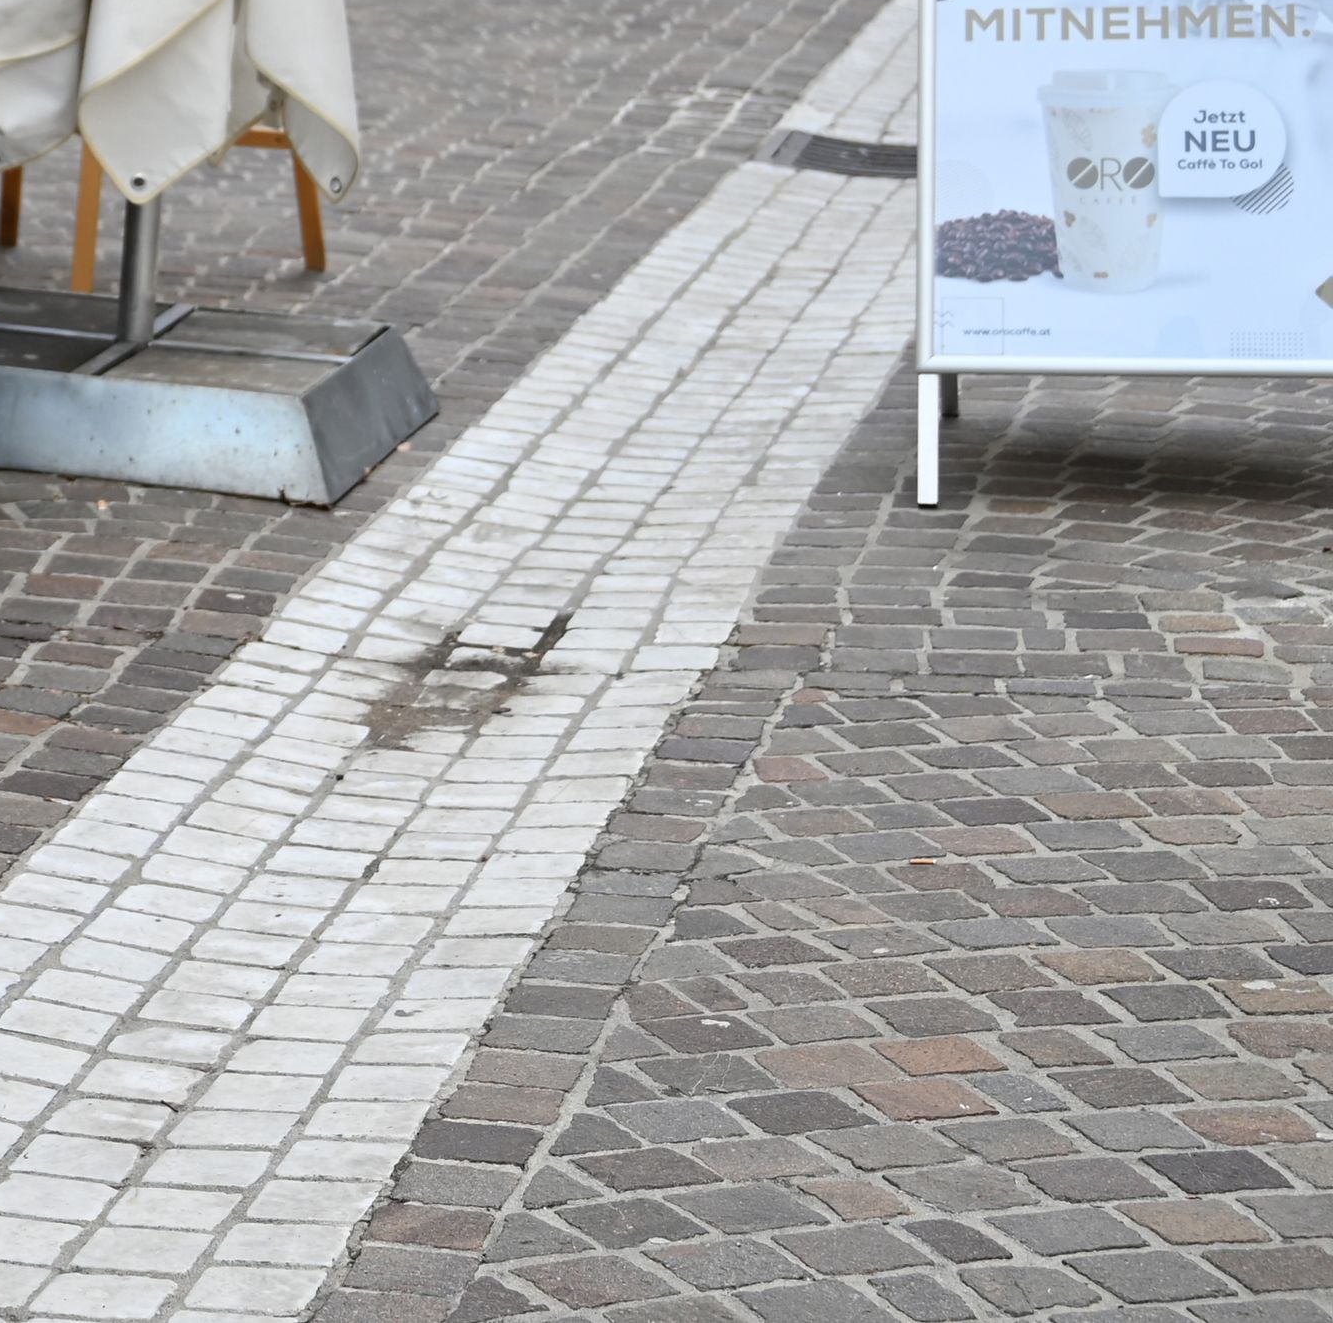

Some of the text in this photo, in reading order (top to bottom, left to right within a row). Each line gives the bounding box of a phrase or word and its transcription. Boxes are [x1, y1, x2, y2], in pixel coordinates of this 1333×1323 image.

[964, 3, 1312, 42] MITNEHMEN.
[1194, 110, 1245, 124] Jetzt
[1184, 130, 1256, 153] NEU
[1220, 158, 1235, 169] To
[1239, 158, 1263, 169] Go!
